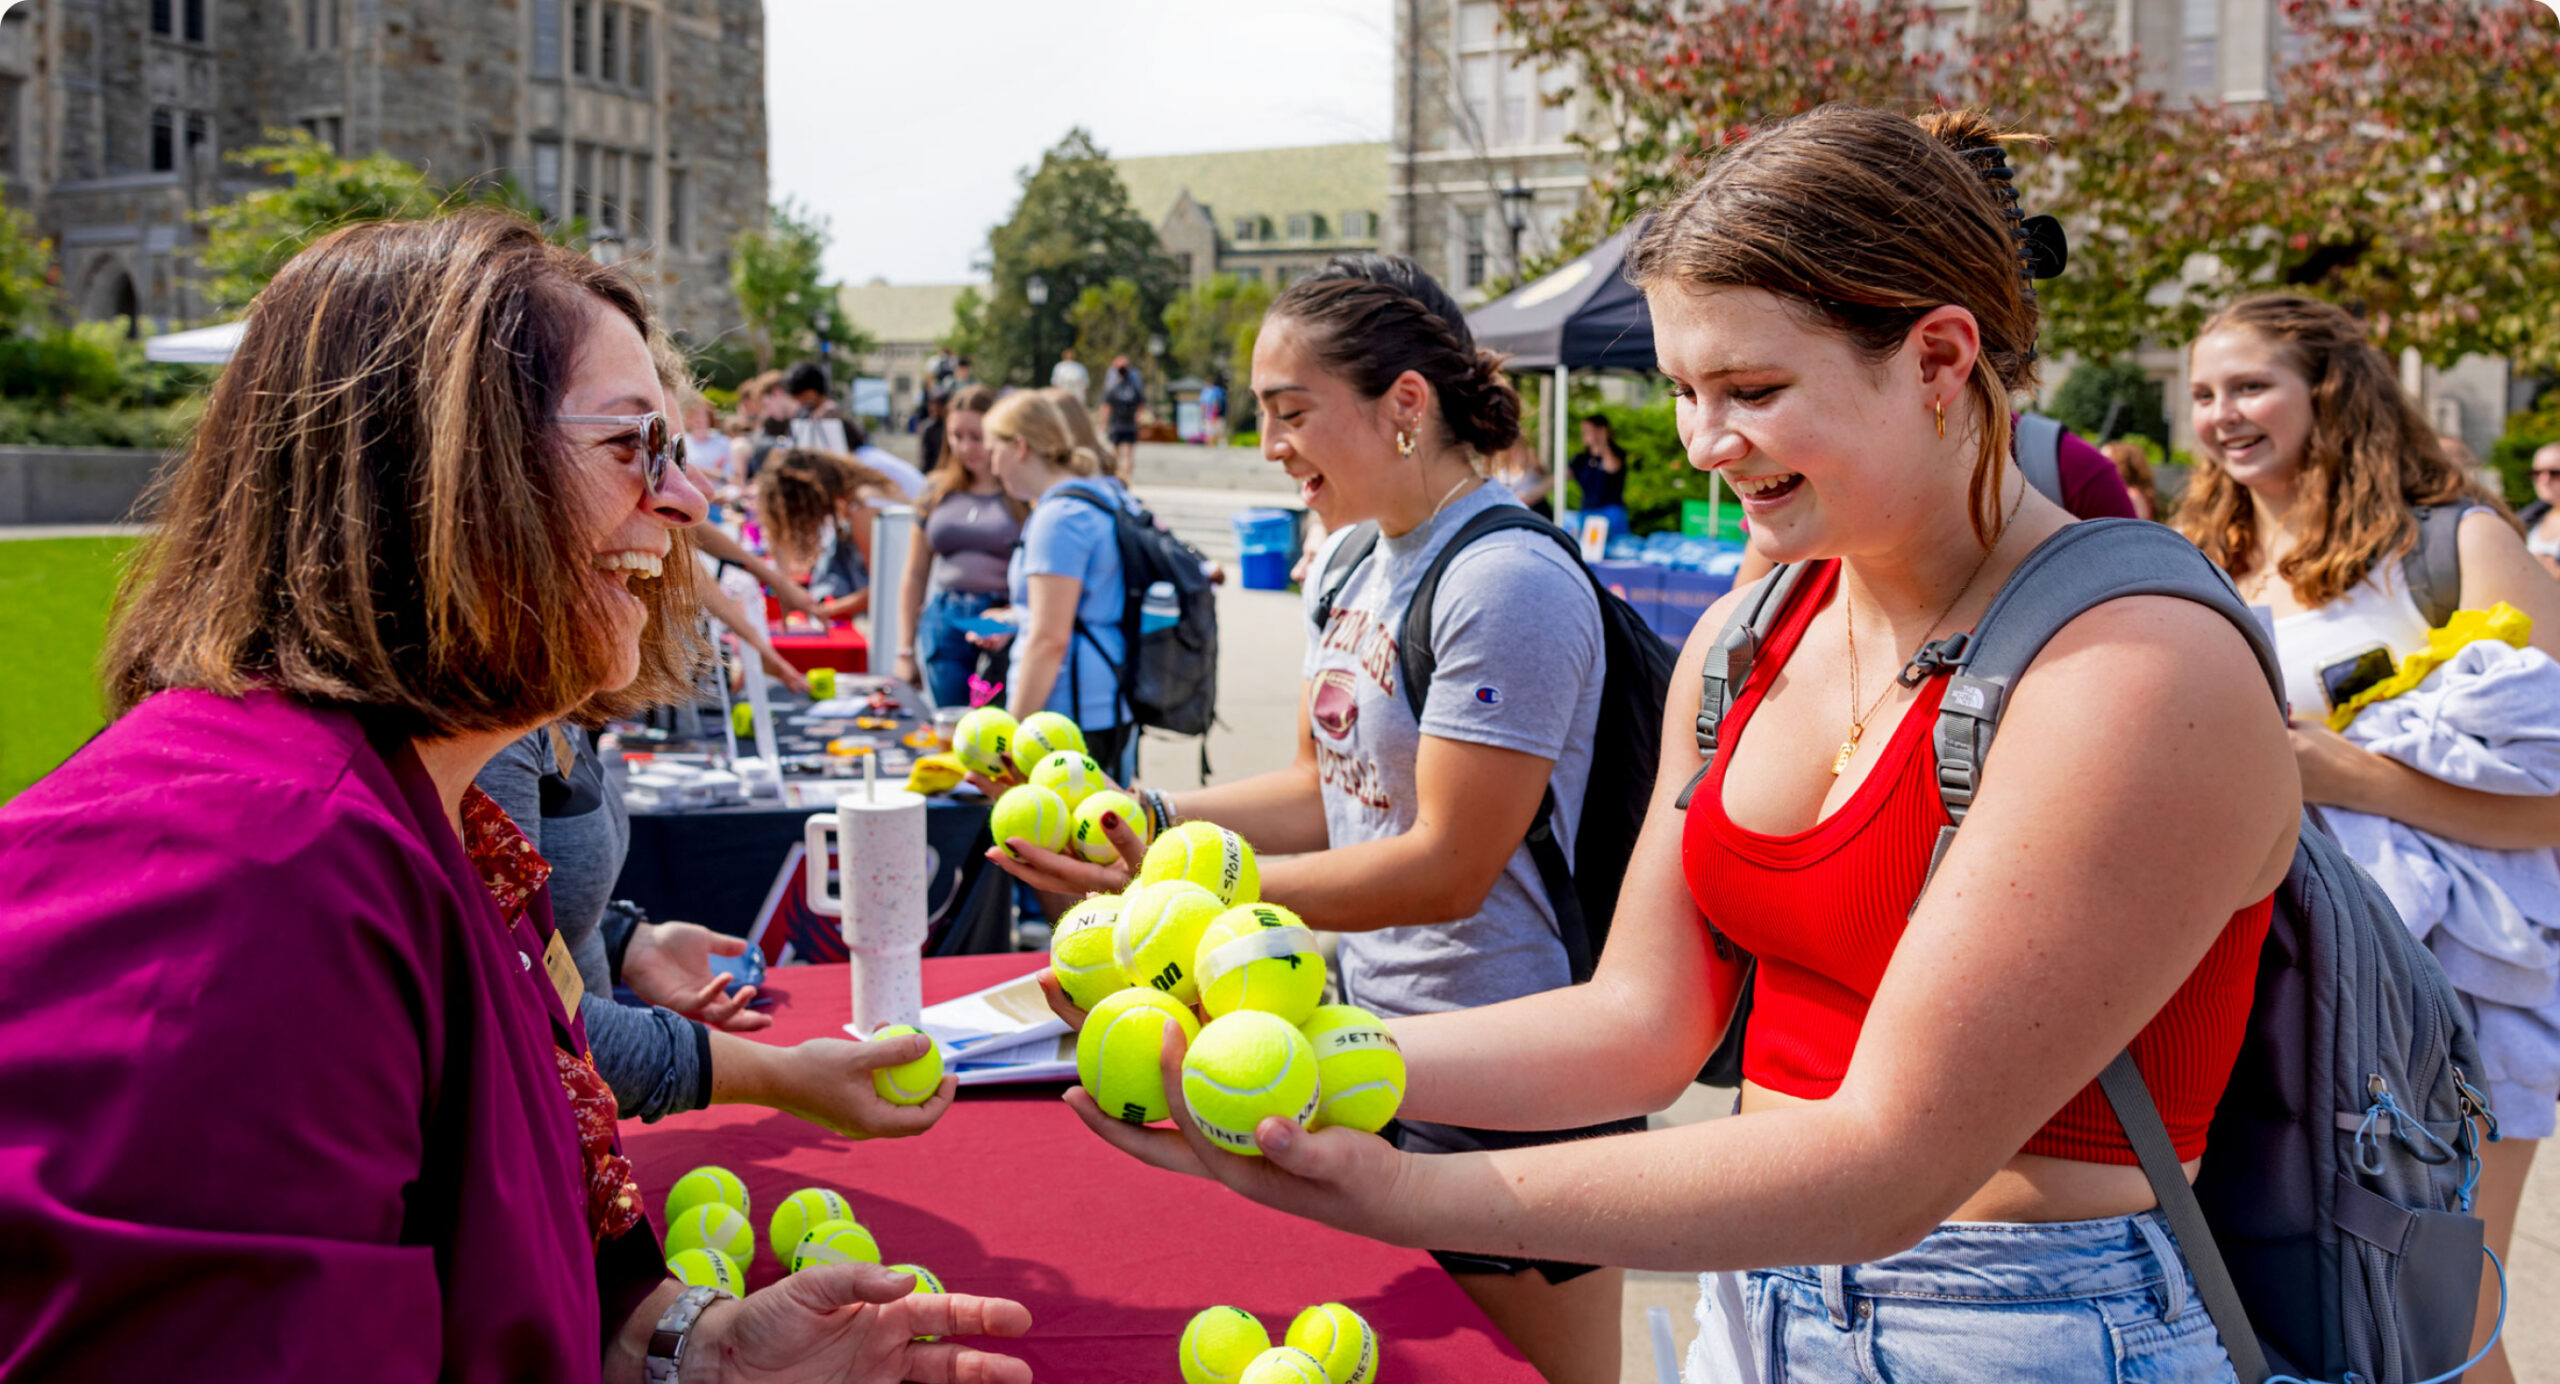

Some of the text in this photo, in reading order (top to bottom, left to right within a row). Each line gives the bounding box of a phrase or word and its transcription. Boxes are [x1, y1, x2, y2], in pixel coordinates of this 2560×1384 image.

[1334, 1032, 1402, 1054] SETTIN
[1196, 1115, 1249, 1145] TIME
[1344, 1323, 1371, 1384] PRESSU
